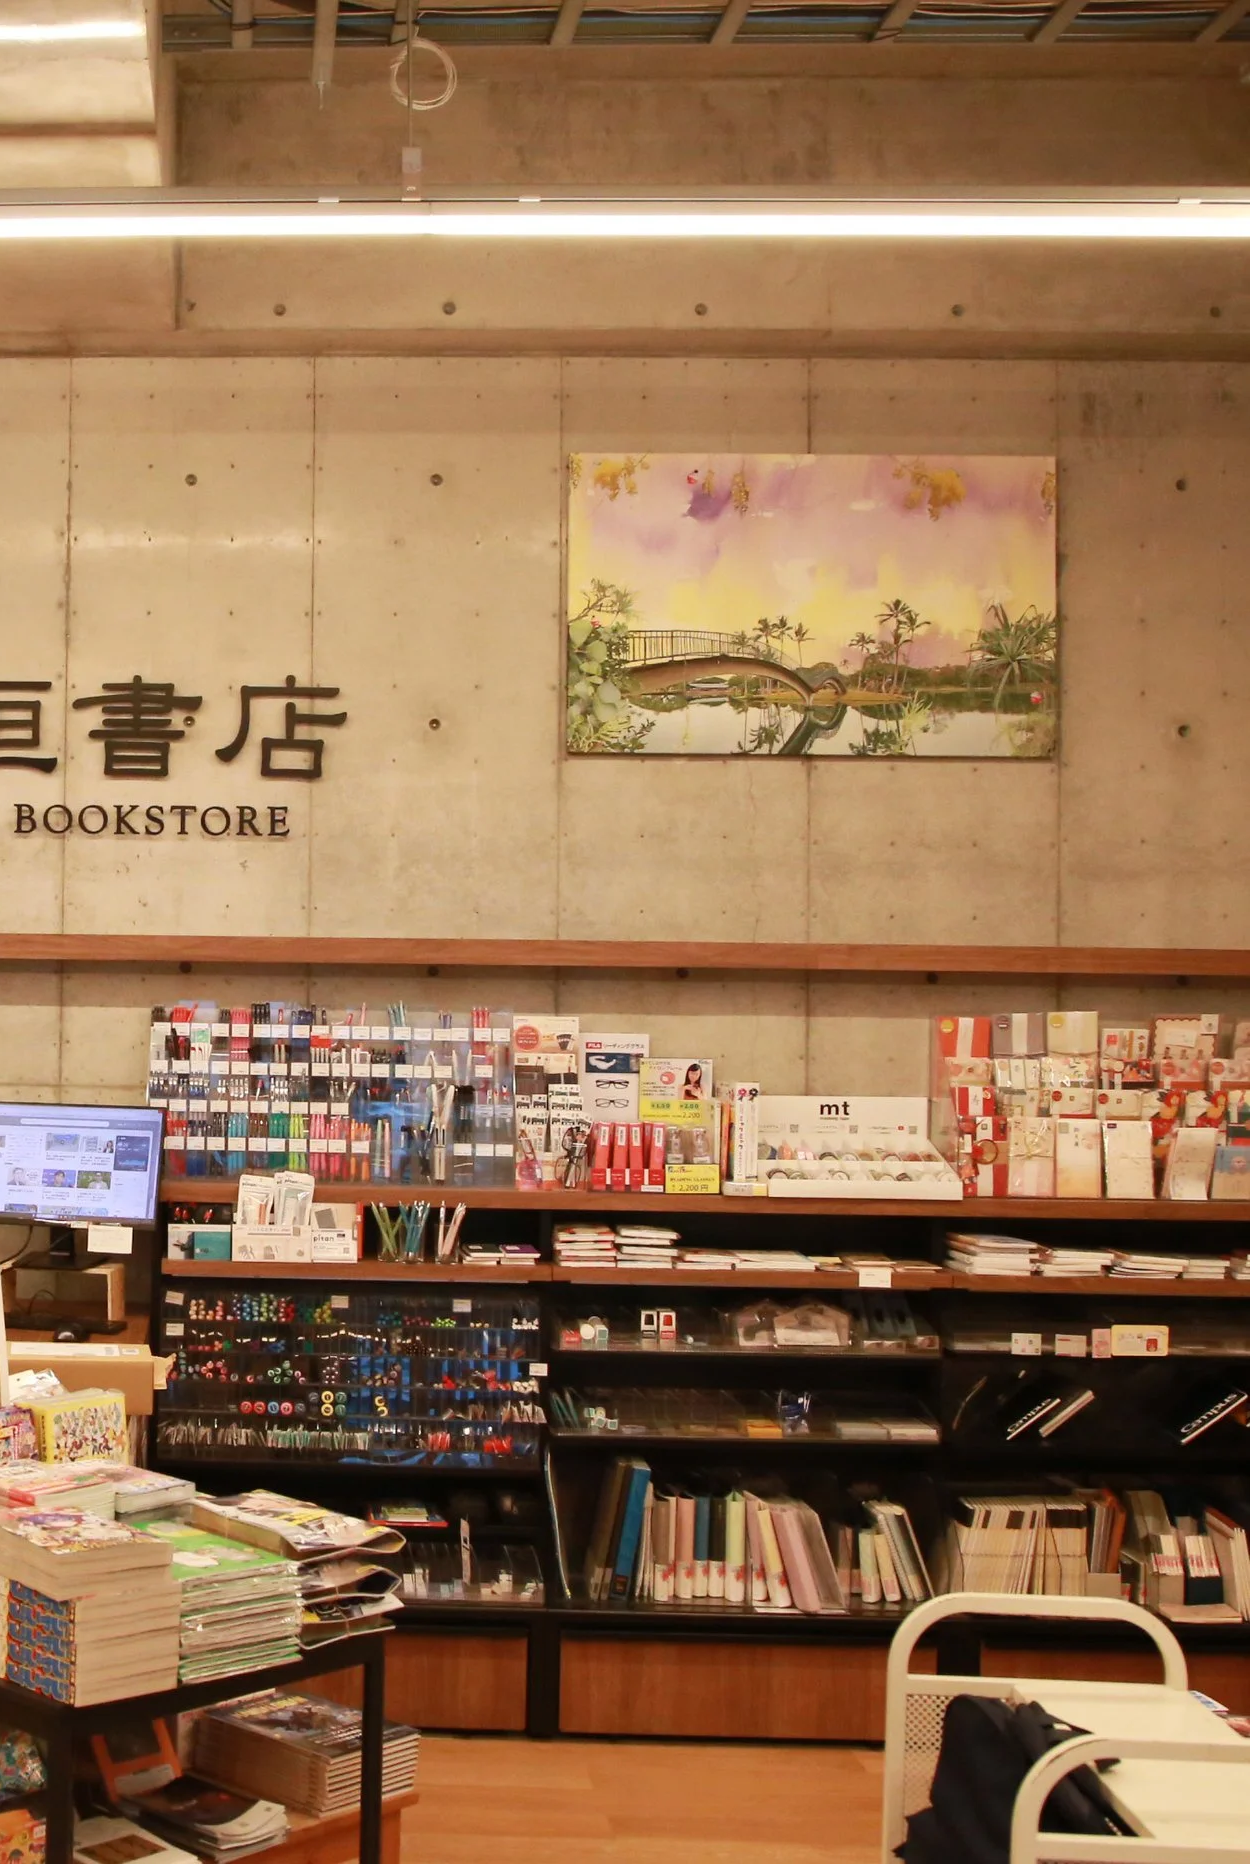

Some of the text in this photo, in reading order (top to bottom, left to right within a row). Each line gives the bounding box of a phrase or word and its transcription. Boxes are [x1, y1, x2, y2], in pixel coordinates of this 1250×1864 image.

[13, 804, 291, 837] BOOKSTORE
[820, 1101, 850, 1116] mt
[1180, 1392, 1238, 1435] Campus
